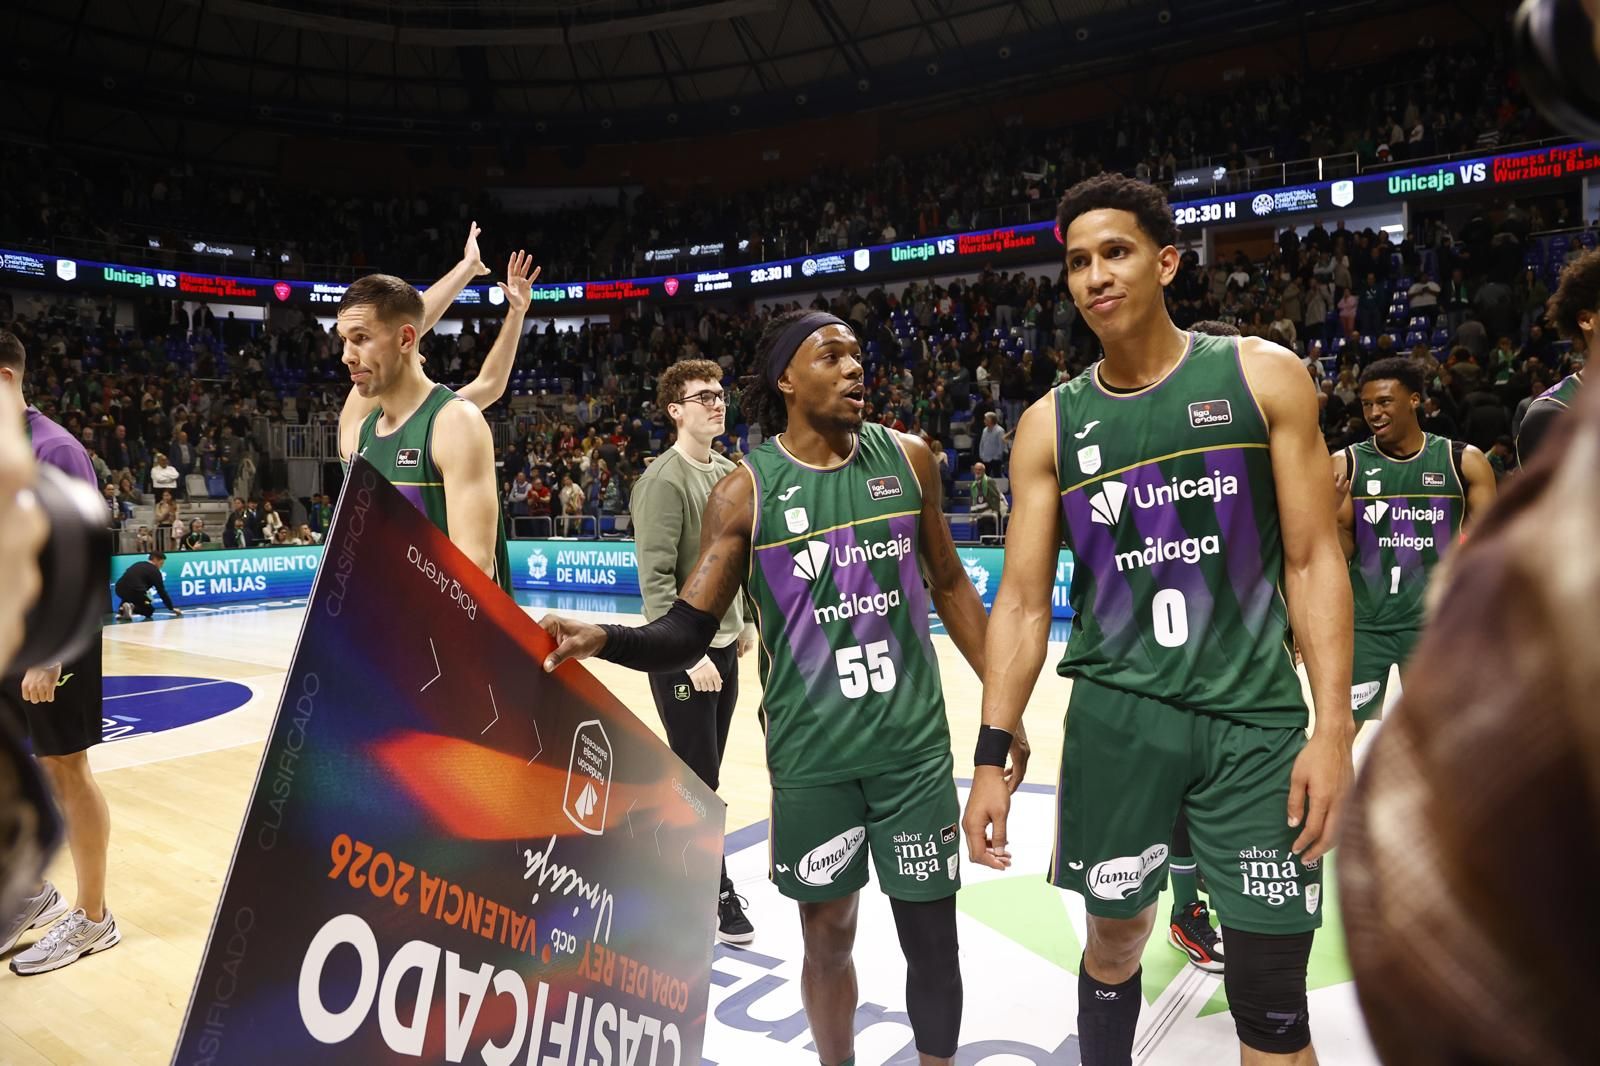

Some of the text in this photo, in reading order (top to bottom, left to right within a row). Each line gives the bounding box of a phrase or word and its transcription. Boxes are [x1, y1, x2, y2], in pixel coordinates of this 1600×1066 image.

[1493, 147, 1584, 170] Fitness First
[1566, 155, 1600, 172] Bask
[1388, 163, 1486, 194] Unicaja VS
[1175, 202, 1236, 225] 20:30 H
[993, 229, 1015, 240] First
[891, 239, 955, 261] Unicaja VS
[104, 267, 176, 287] Unicaja VS
[751, 265, 792, 283] 20:30 H
[310, 293, 320, 301] 21
[568, 286, 583, 298] VS
[1194, 414, 1229, 424] endesa
[872, 484, 885, 492] liga
[873, 487, 900, 497] endesa
[1134, 470, 1238, 509] Unicaja
[1392, 507, 1444, 524] Unicaja
[326, 470, 377, 617] CLASIFICADO
[835, 533, 911, 567] Unicaja
[180, 554, 318, 578] AYUNTAMIENTO
[556, 550, 639, 567] AYUNTAMIEN
[181, 576, 267, 596] DE MIJAS
[407, 544, 477, 620] Roig Arena
[557, 568, 616, 585] DE MIJAS
[1390, 566, 1401, 594] 1
[1152, 588, 1188, 648] 0
[835, 639, 897, 699] 55
[258, 672, 320, 850] CLASIFICADO
[893, 832, 922, 843] sabor
[803, 830, 864, 879] famadesa
[1239, 846, 1279, 859] sabor
[897, 855, 941, 881] laga
[328, 833, 537, 957] VALENCIA 2026
[523, 833, 613, 944] Unicaja
[1242, 873, 1300, 905] laga
[551, 928, 576, 954] acb
[192, 907, 255, 1066] ASIFICADO
[577, 941, 689, 1013] COPA DEL REY
[298, 913, 682, 1066] CLASIFICADO
